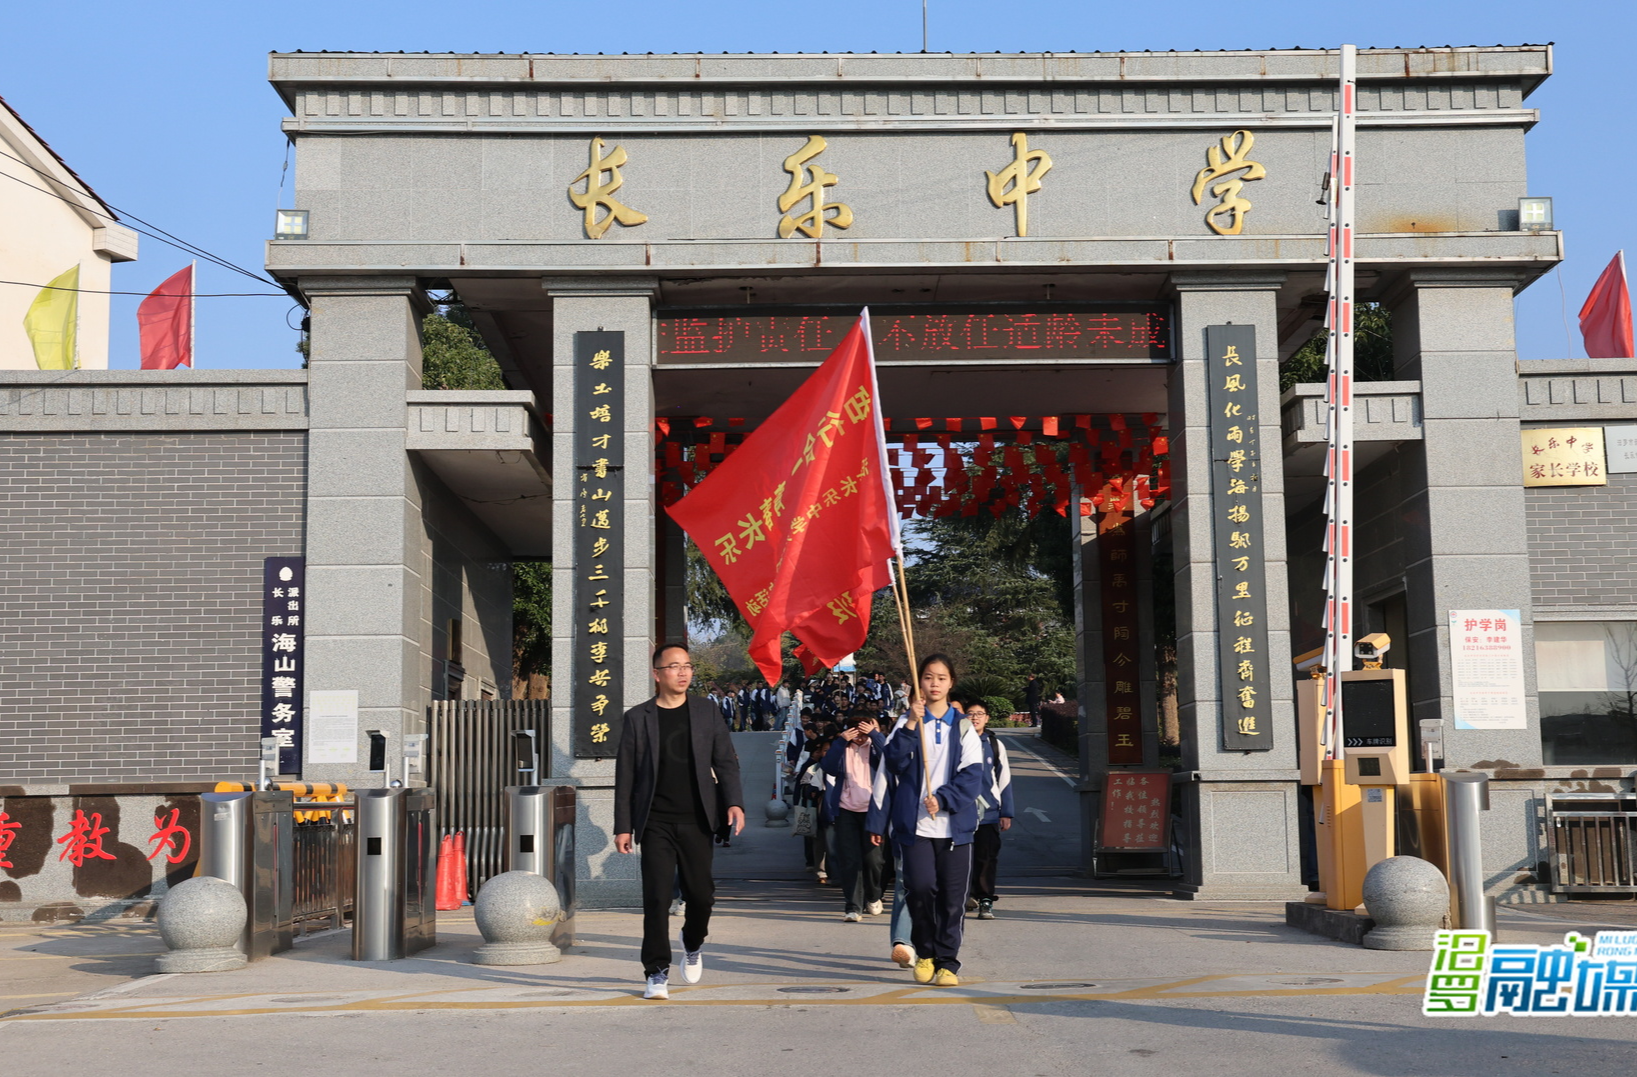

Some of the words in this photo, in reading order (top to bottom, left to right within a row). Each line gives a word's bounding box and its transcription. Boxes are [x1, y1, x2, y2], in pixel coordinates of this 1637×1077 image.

[568, 130, 1267, 240] 长乐中学
[1531, 435, 1594, 455] 长乐中学
[1529, 462, 1599, 479] 家长学校
[271, 587, 285, 626] 长乐
[287, 587, 300, 626] 派出所
[1464, 618, 1507, 632] 护学岗
[271, 633, 297, 747] 海山警务室
[1366, 738, 1393, 746] 车牌识别
